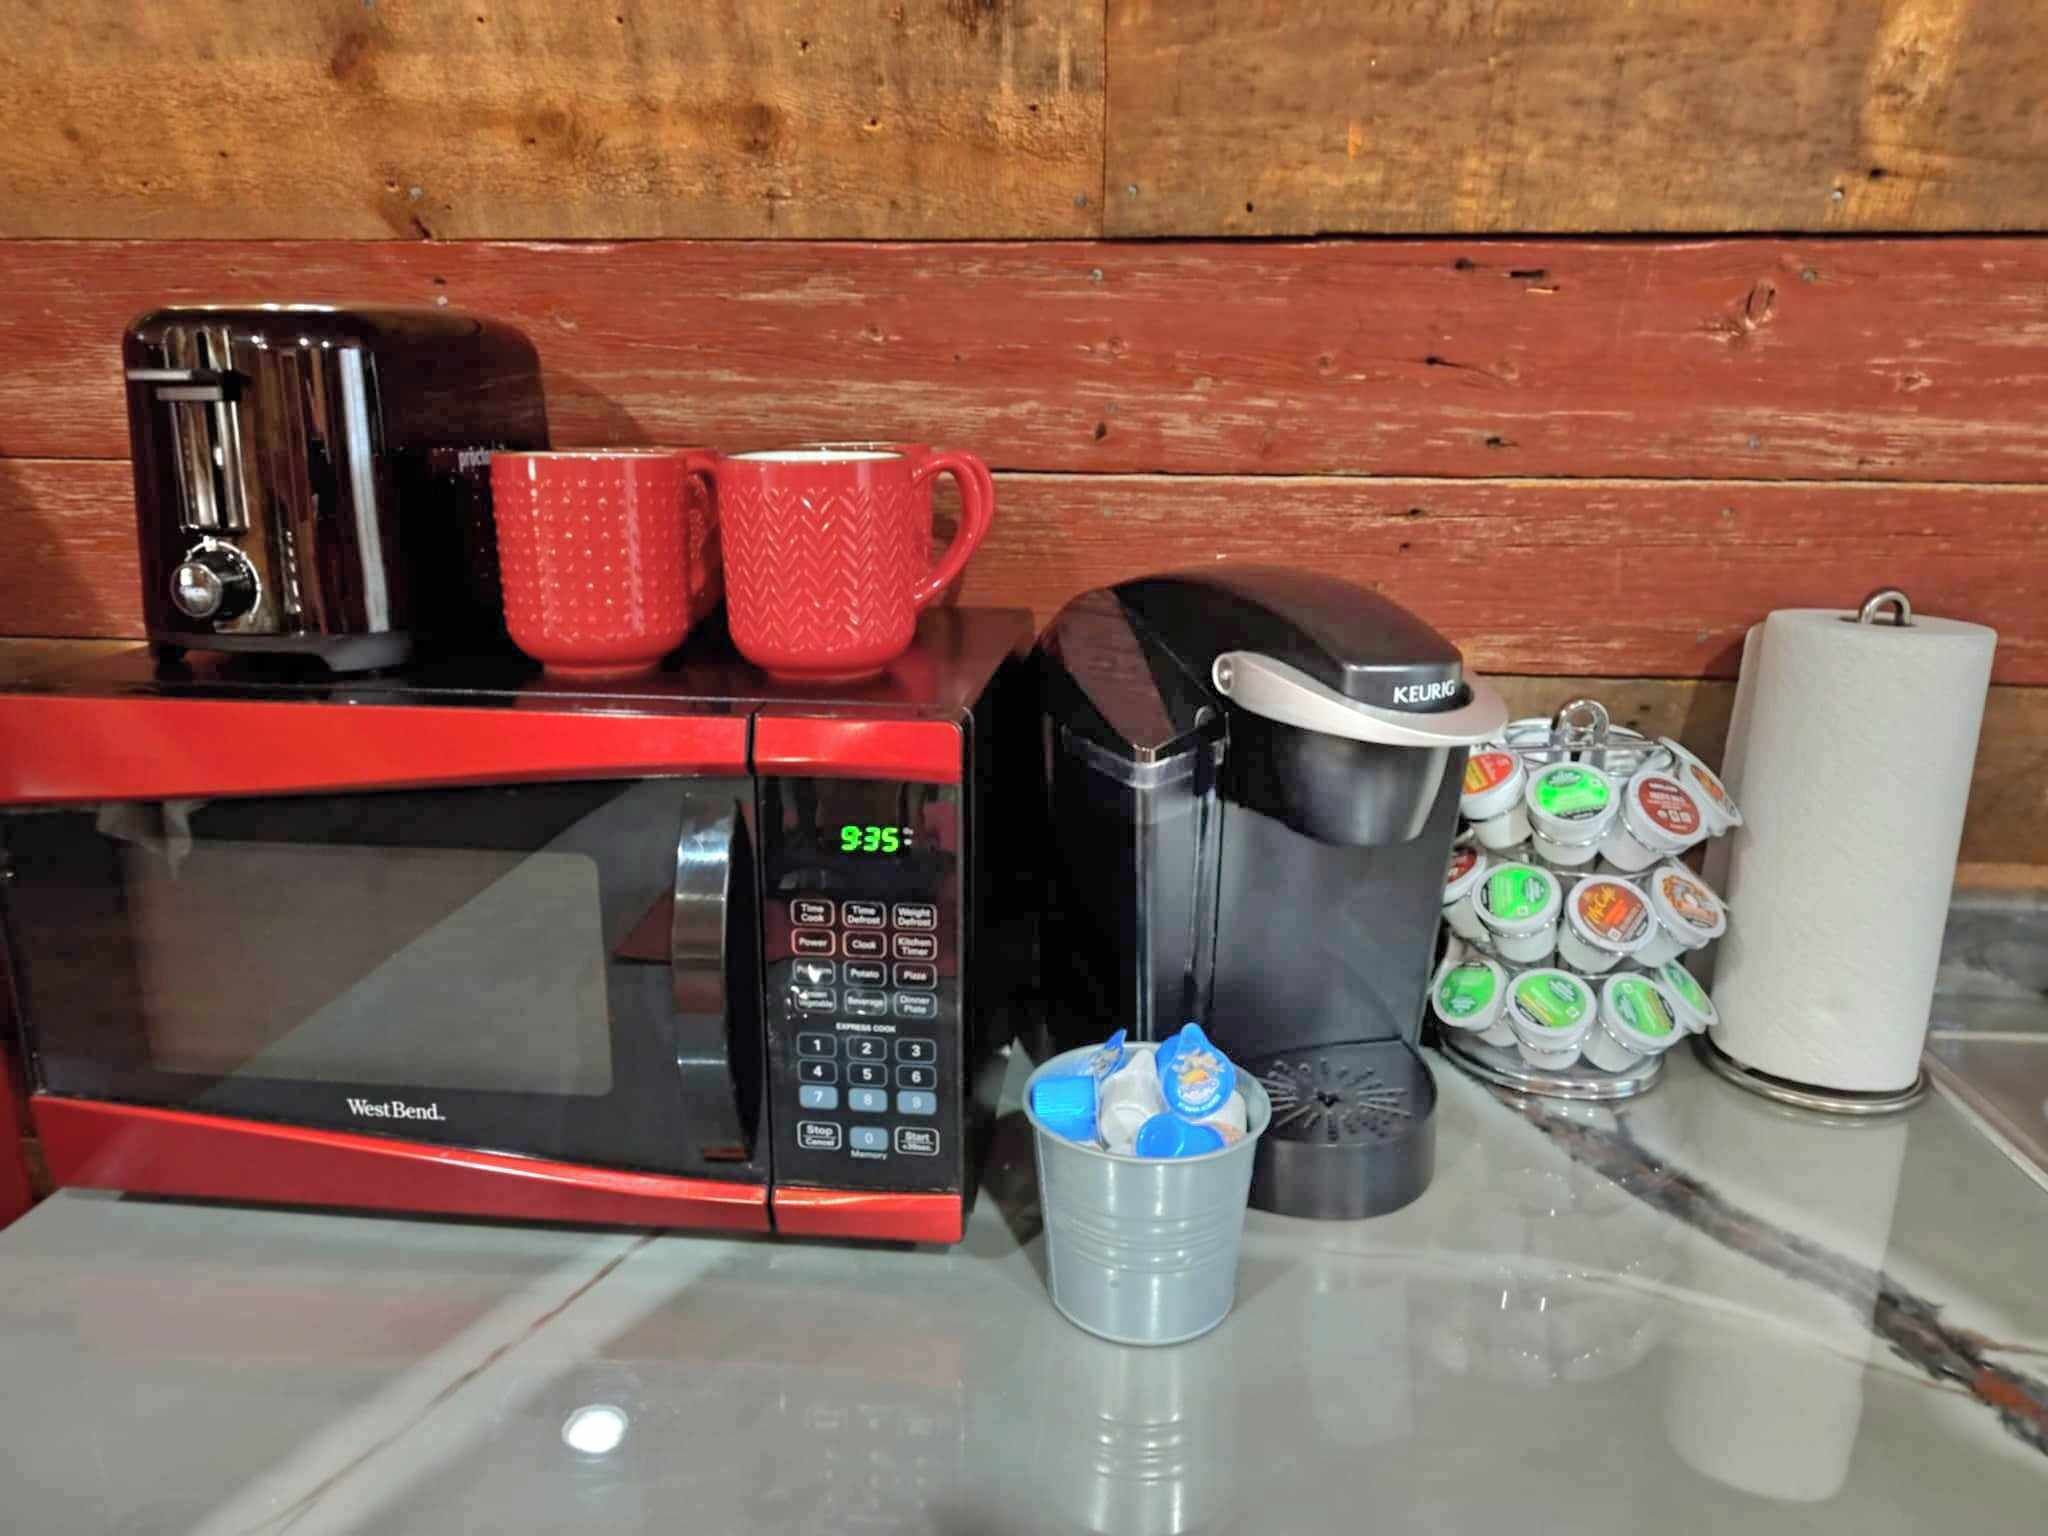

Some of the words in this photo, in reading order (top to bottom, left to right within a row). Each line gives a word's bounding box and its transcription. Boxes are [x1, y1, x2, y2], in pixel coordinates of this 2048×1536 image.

[1393, 680, 1456, 704] KEURIG
[840, 825, 900, 853] 9:35
[801, 904, 825, 913] Time
[852, 905, 876, 915] Time
[898, 908, 931, 919] Weight
[801, 913, 825, 923] Cook
[847, 914, 881, 925] Defrost
[898, 917, 931, 928] Defrost
[799, 937, 828, 948] Power
[852, 939, 877, 951] Clock
[898, 938, 932, 948] Kitchen
[902, 946, 929, 957] Timer
[850, 968, 880, 979] Potato
[903, 970, 928, 981] Pizza
[847, 997, 884, 1008] Beverage
[900, 995, 931, 1006] Dinner
[904, 1004, 928, 1014] Plate
[835, 1022, 872, 1032] EXPRESS
[873, 1023, 896, 1033] COOK
[813, 1039, 821, 1051] 1
[861, 1043, 872, 1055] 2
[911, 1045, 921, 1057] 3
[813, 1065, 823, 1077] 4
[862, 1068, 872, 1080] 5
[911, 1071, 922, 1083] 6
[813, 1091, 823, 1103] 7
[863, 1093, 873, 1106] 8
[912, 1096, 922, 1109] 9
[346, 1097, 391, 1118] West
[391, 1100, 440, 1121] Bend
[806, 1125, 833, 1136] Stop
[864, 1132, 874, 1145] 0
[905, 1131, 931, 1142] Start
[805, 1138, 835, 1147] Cancel
[851, 1150, 887, 1161] Memory
